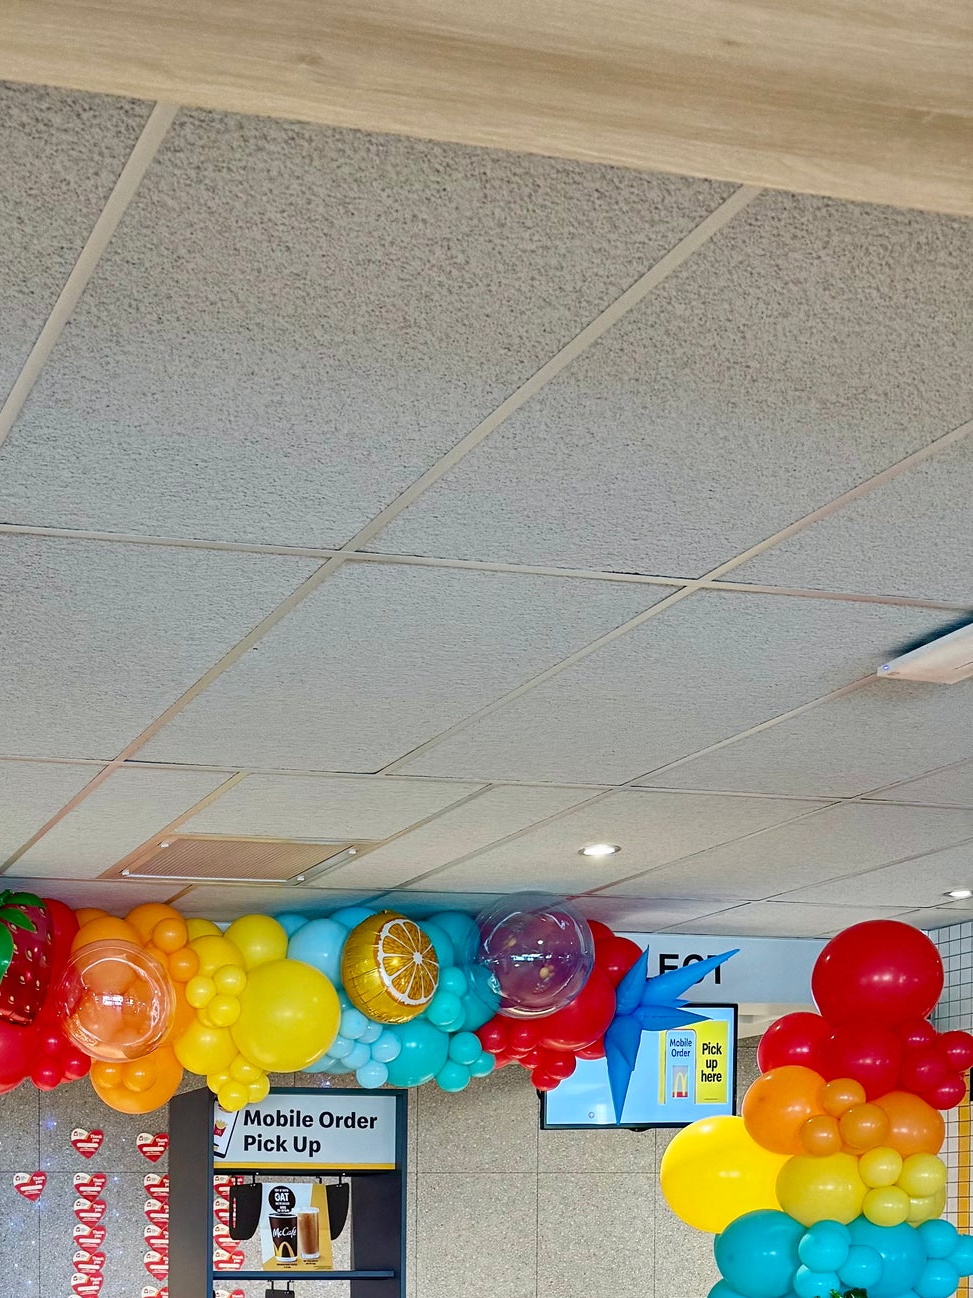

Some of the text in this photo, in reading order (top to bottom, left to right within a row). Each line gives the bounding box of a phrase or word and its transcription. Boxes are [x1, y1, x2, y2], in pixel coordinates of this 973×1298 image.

[670, 1038, 692, 1047] Mobile
[702, 1042, 722, 1055] Pick
[671, 1049, 690, 1057] Order
[706, 1059, 718, 1072] up
[701, 1070, 722, 1082] here
[244, 1110, 378, 1128] Mobile Order
[244, 1134, 321, 1157] Pick Up
